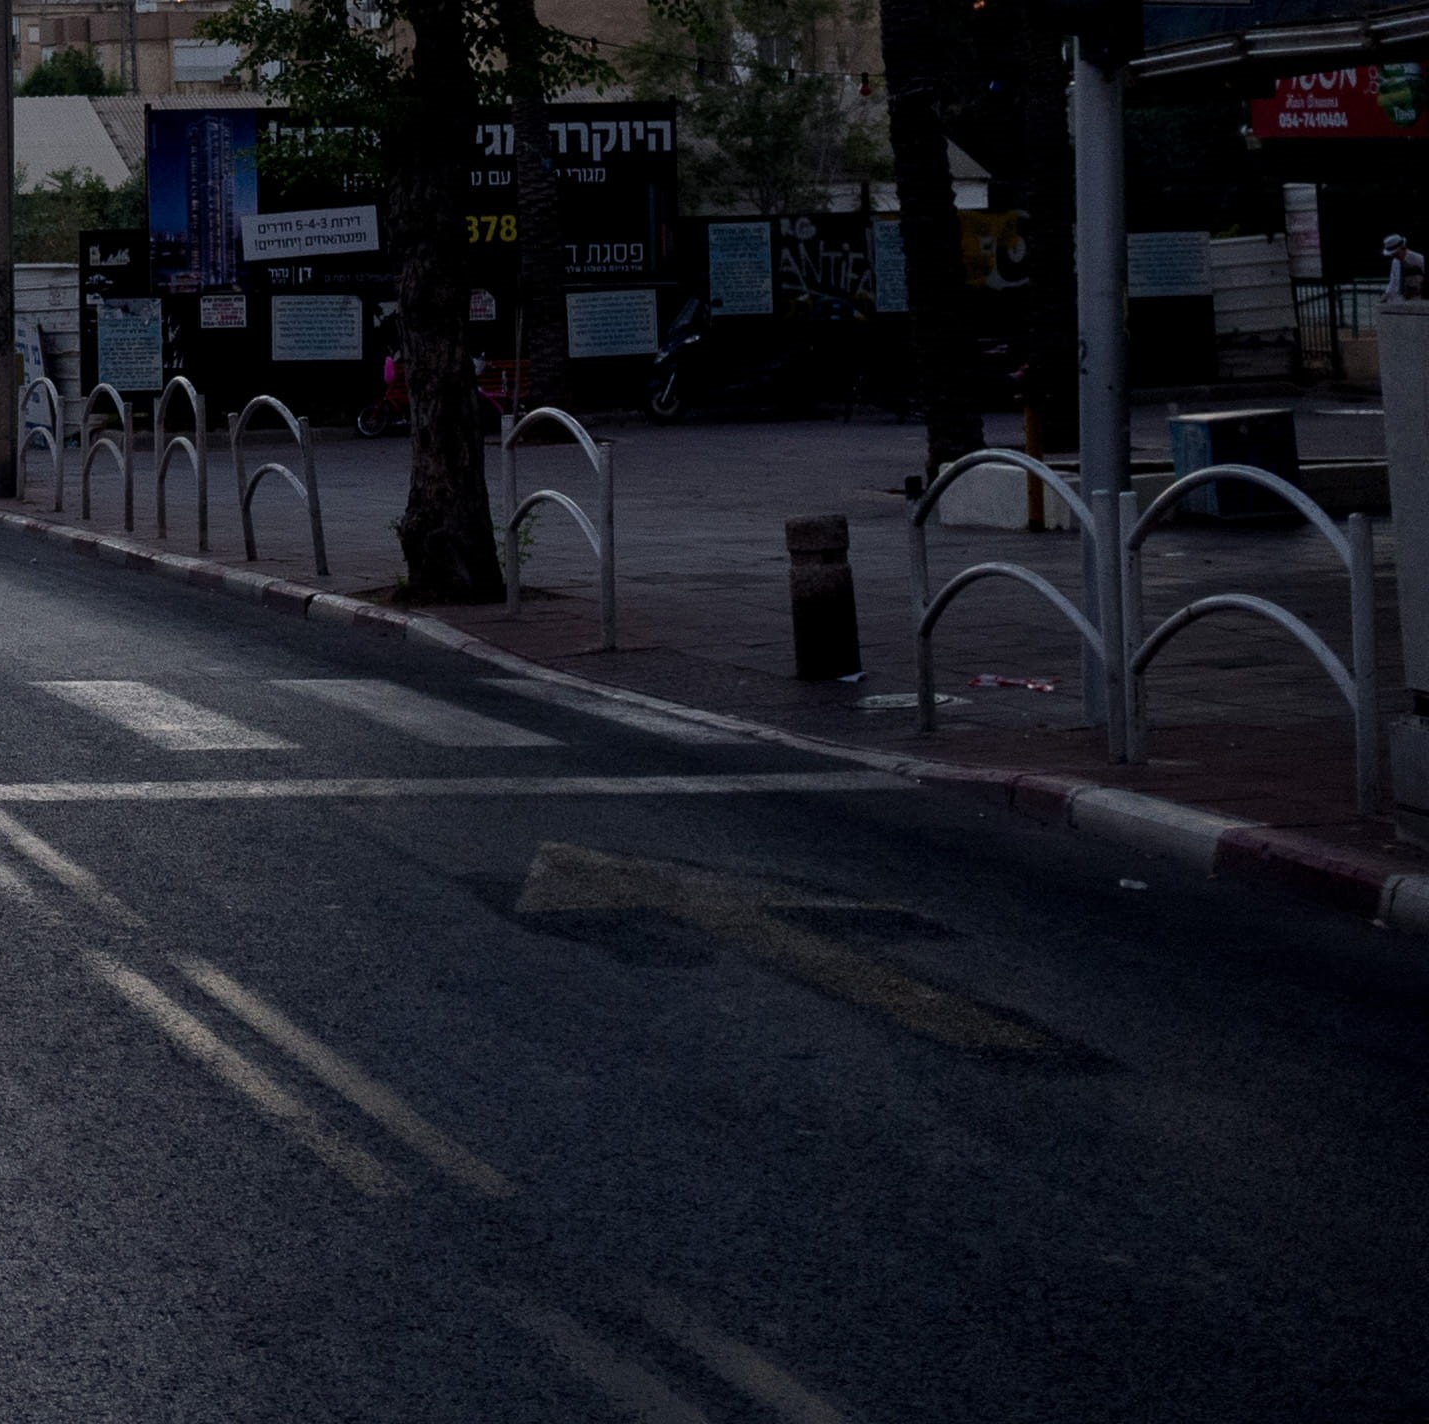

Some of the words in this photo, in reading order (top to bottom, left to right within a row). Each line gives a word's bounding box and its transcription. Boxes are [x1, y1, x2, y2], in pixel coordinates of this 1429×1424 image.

[487, 170, 511, 186] עם
[258, 221, 293, 235] חדרים
[330, 215, 361, 229] דירות
[585, 241, 645, 264] פסגת
